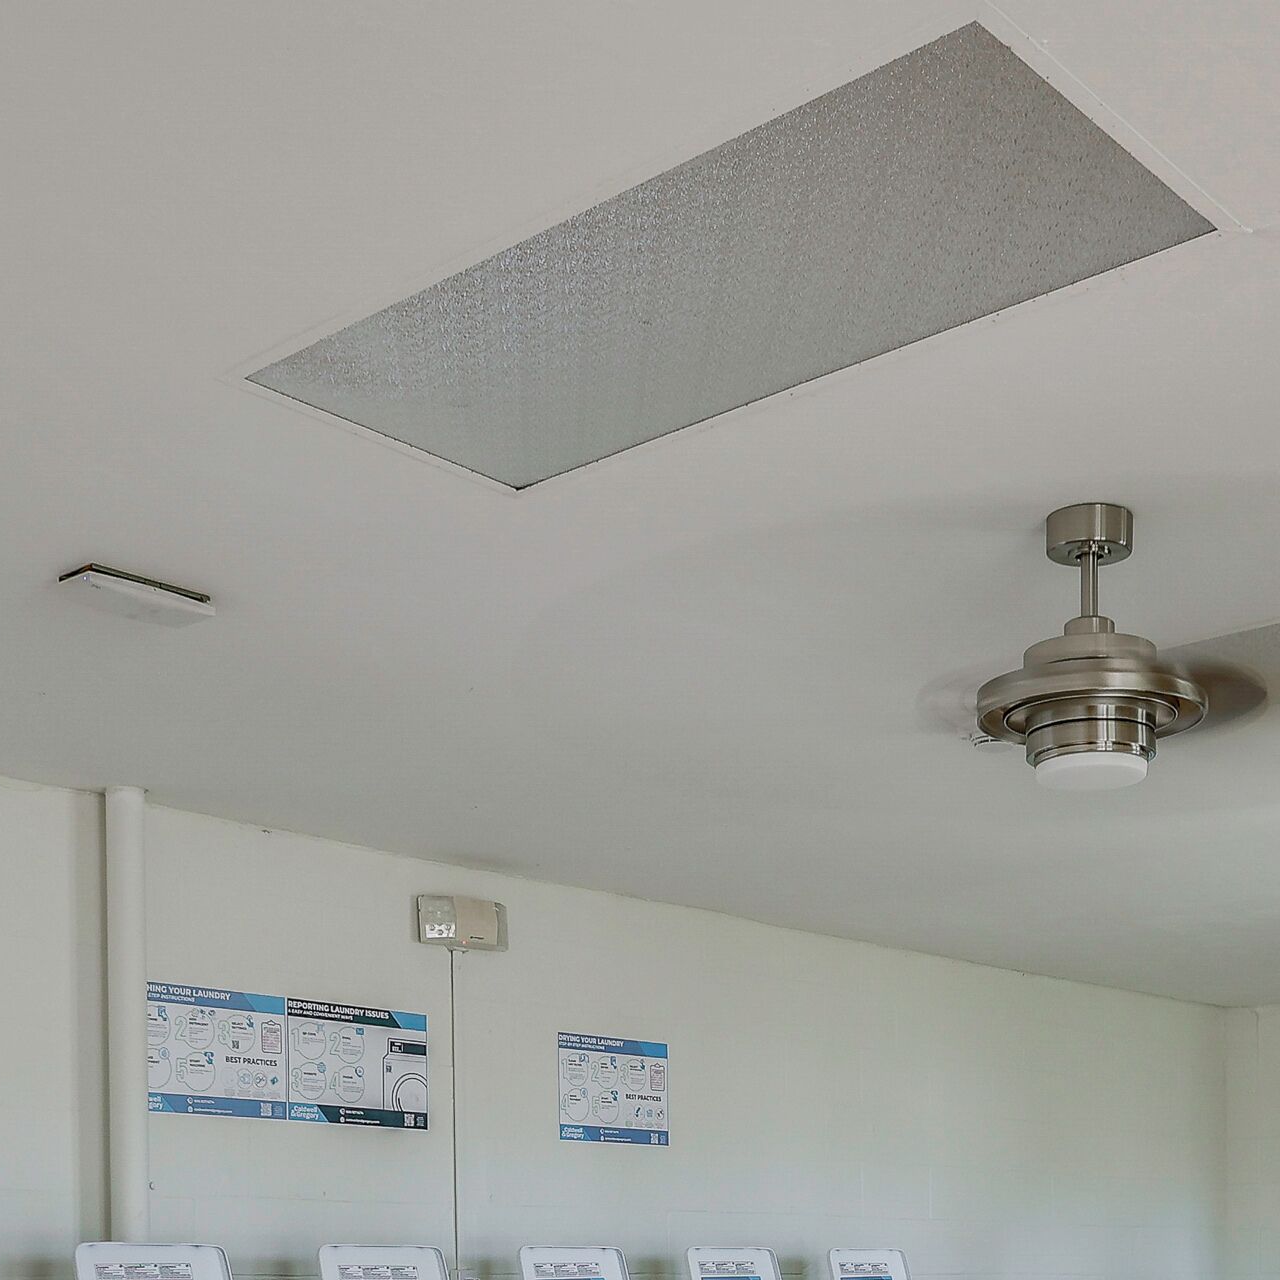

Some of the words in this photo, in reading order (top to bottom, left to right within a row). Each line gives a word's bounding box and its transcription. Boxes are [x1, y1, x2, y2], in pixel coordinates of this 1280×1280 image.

[168, 986, 191, 996] YOUR
[193, 990, 231, 1000] LAUNDRY
[288, 1000, 329, 1012] REPORTING
[331, 1006, 364, 1017] LAUNDRY
[365, 1010, 389, 1019] ISSUES
[598, 1039, 624, 1047] LAUNDRY
[226, 1056, 241, 1064] BEST
[243, 1058, 278, 1067] PRACTICES
[294, 1105, 318, 1113] Caldwell
